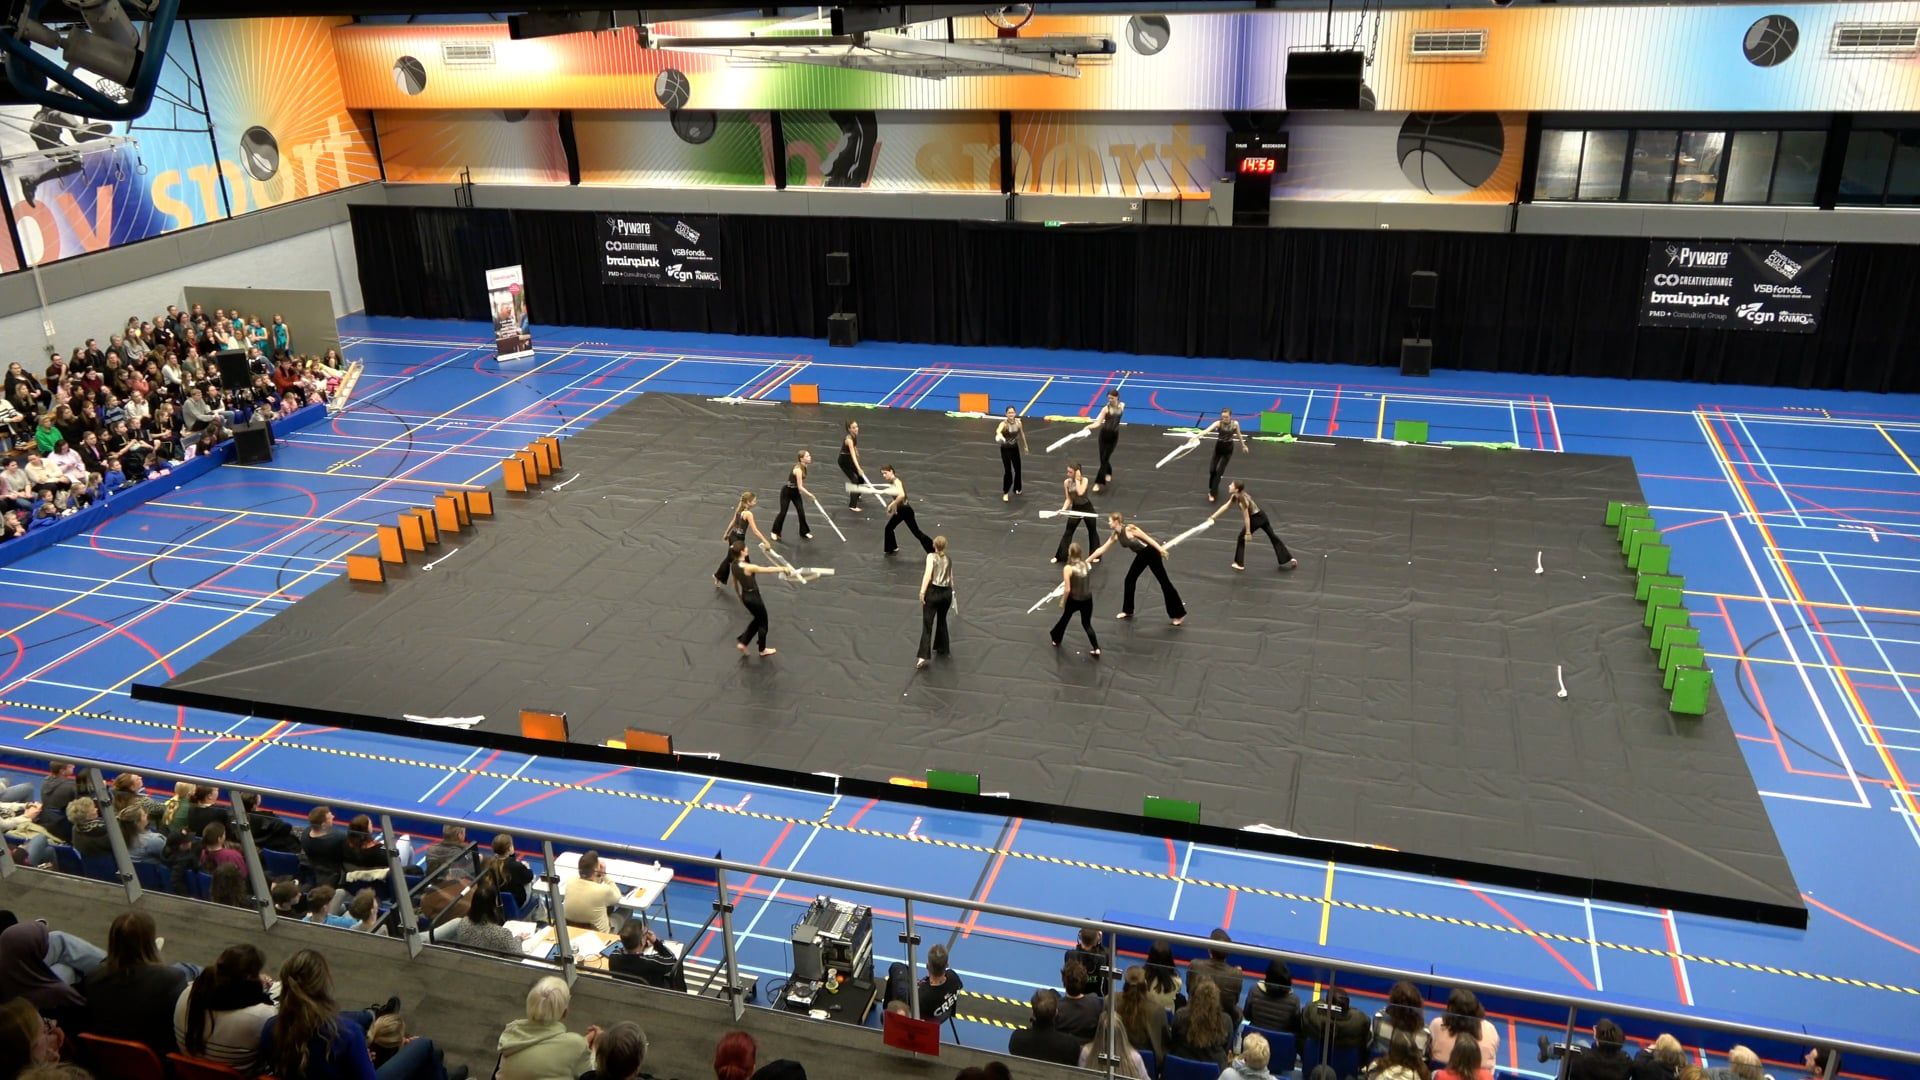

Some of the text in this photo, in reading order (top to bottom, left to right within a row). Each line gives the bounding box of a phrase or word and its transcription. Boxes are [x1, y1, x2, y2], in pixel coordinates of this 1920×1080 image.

[1241, 158, 1275, 172] 14:59
[617, 219, 651, 236] Pyware
[606, 254, 661, 268] brainpink
[1679, 247, 1729, 268] Pyware
[1650, 290, 1731, 307] brainpink
